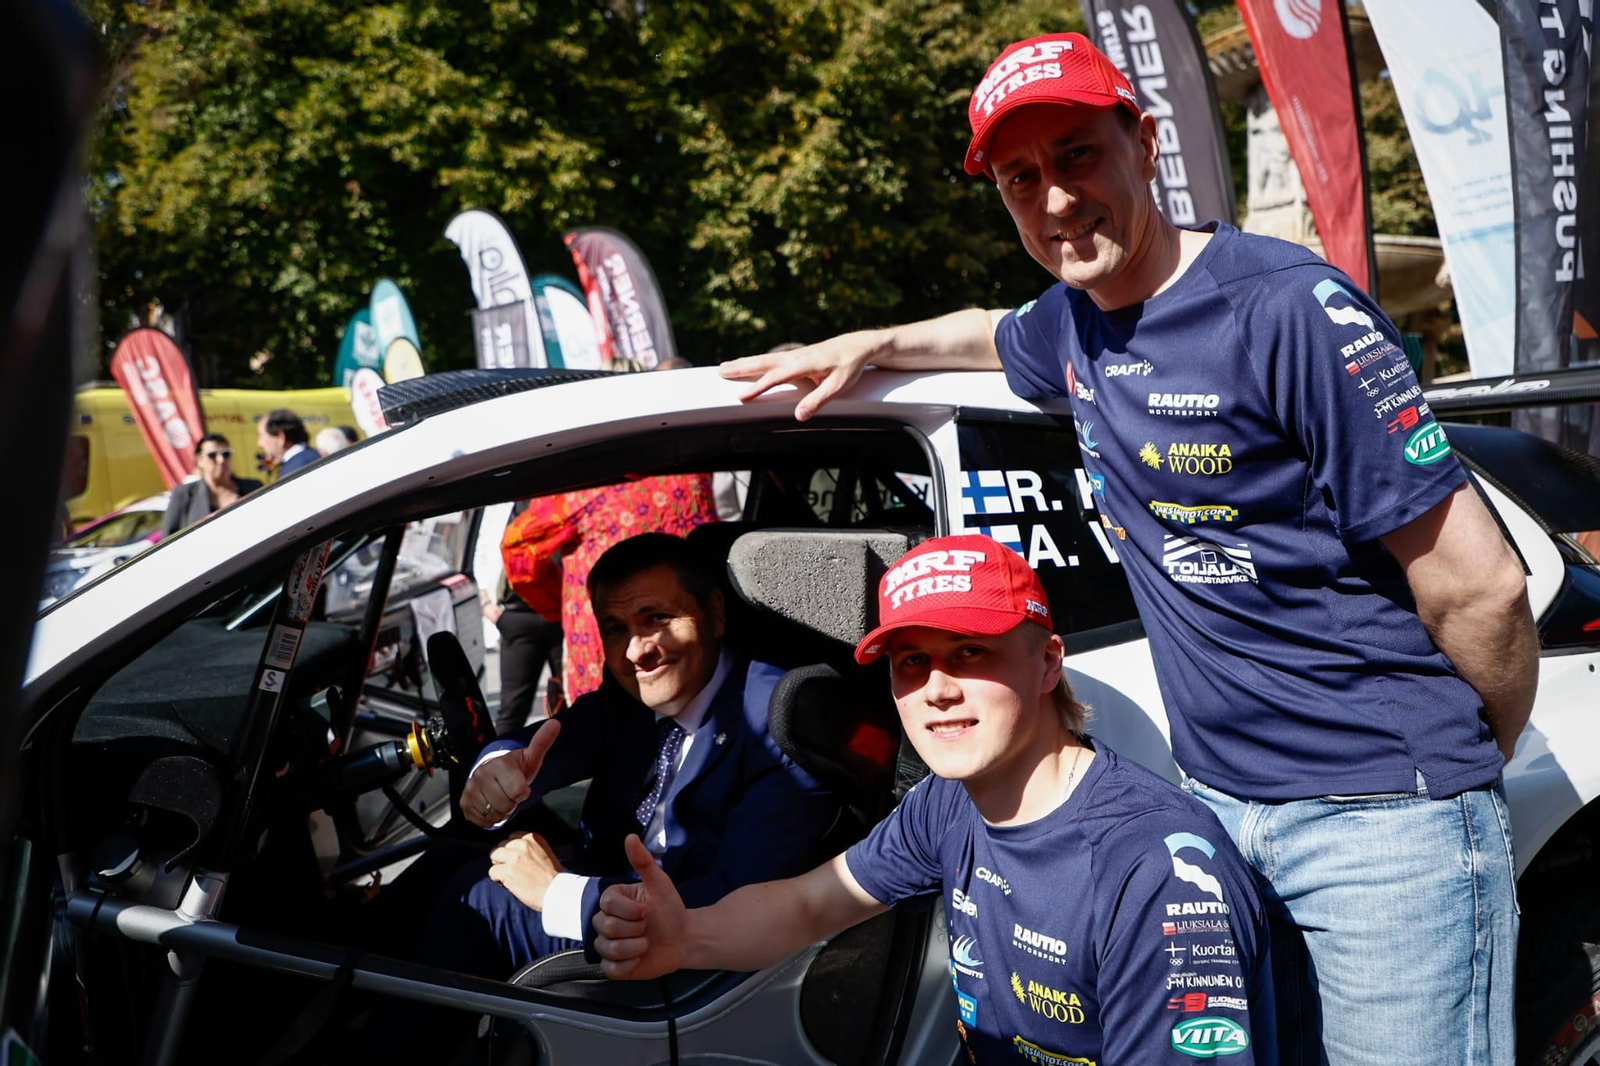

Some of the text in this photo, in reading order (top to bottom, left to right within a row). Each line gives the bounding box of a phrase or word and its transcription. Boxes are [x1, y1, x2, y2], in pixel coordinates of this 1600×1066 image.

[975, 41, 1073, 112] MRF
[983, 62, 1063, 117] TYRES
[1105, 362, 1144, 378] CRAFT
[1148, 392, 1220, 409] RAUTIO
[1148, 409, 1218, 417] MOTORSPORT
[1167, 442, 1232, 457] ANAIKA
[1405, 425, 1448, 460] VIIT
[1168, 457, 1233, 475] WOOD
[1005, 470, 1063, 513] R.
[1028, 524, 1080, 569] A.
[884, 550, 986, 597] MRF
[1167, 561, 1246, 576] TOIJALA
[891, 575, 972, 609] TYRES
[1012, 939, 1067, 966] MOTORSPORT
[1013, 923, 1067, 956] RAUTIO
[1028, 979, 1082, 1007] ANAIKA
[1186, 974, 1233, 988] KINNUNEN
[1028, 992, 1085, 1024] WOOD
[1171, 1026, 1248, 1047] VIITA
